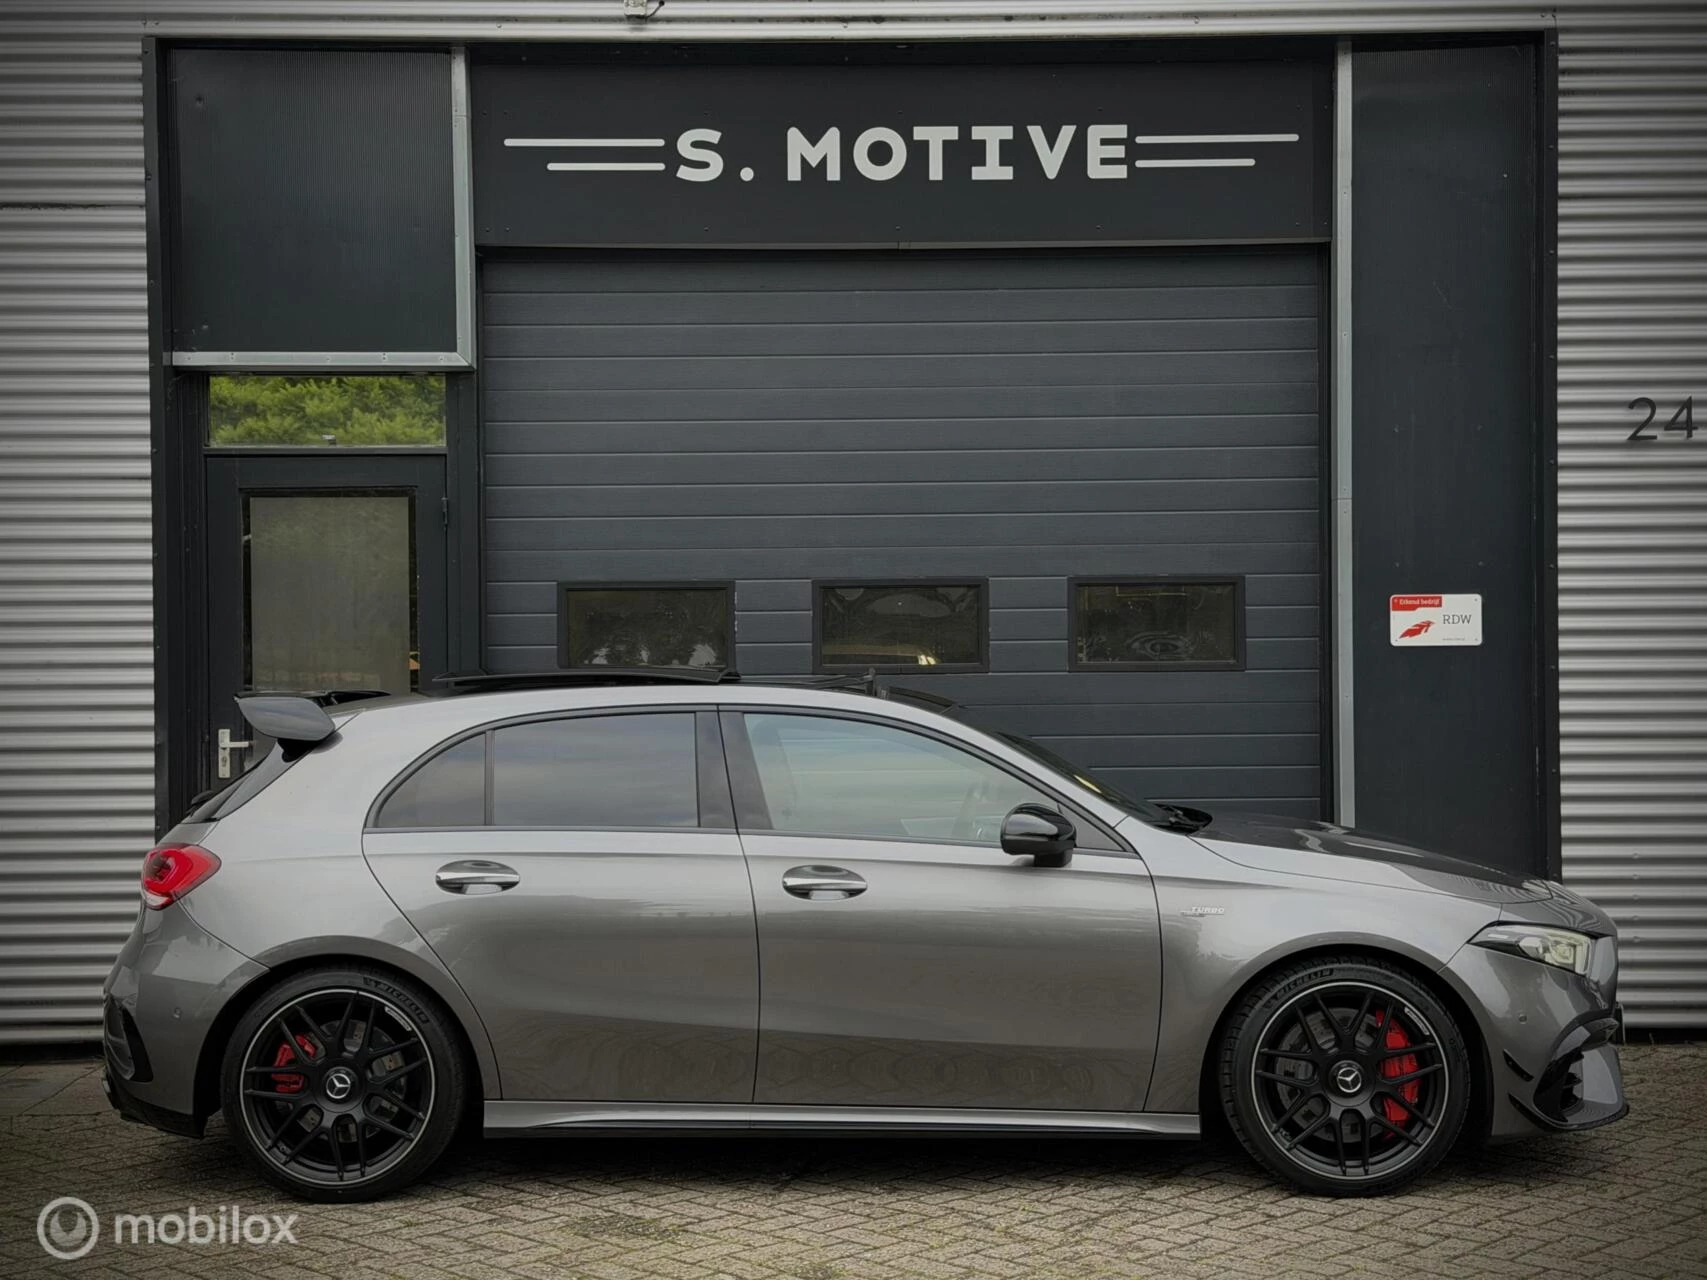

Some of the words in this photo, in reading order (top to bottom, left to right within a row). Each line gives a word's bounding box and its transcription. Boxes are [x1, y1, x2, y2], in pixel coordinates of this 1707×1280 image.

[677, 128, 753, 181] S.
[787, 125, 1128, 181] MOTIVE
[1627, 396, 1698, 440] 24
[1442, 614, 1472, 625] RDW
[1191, 906, 1225, 914] TURBO
